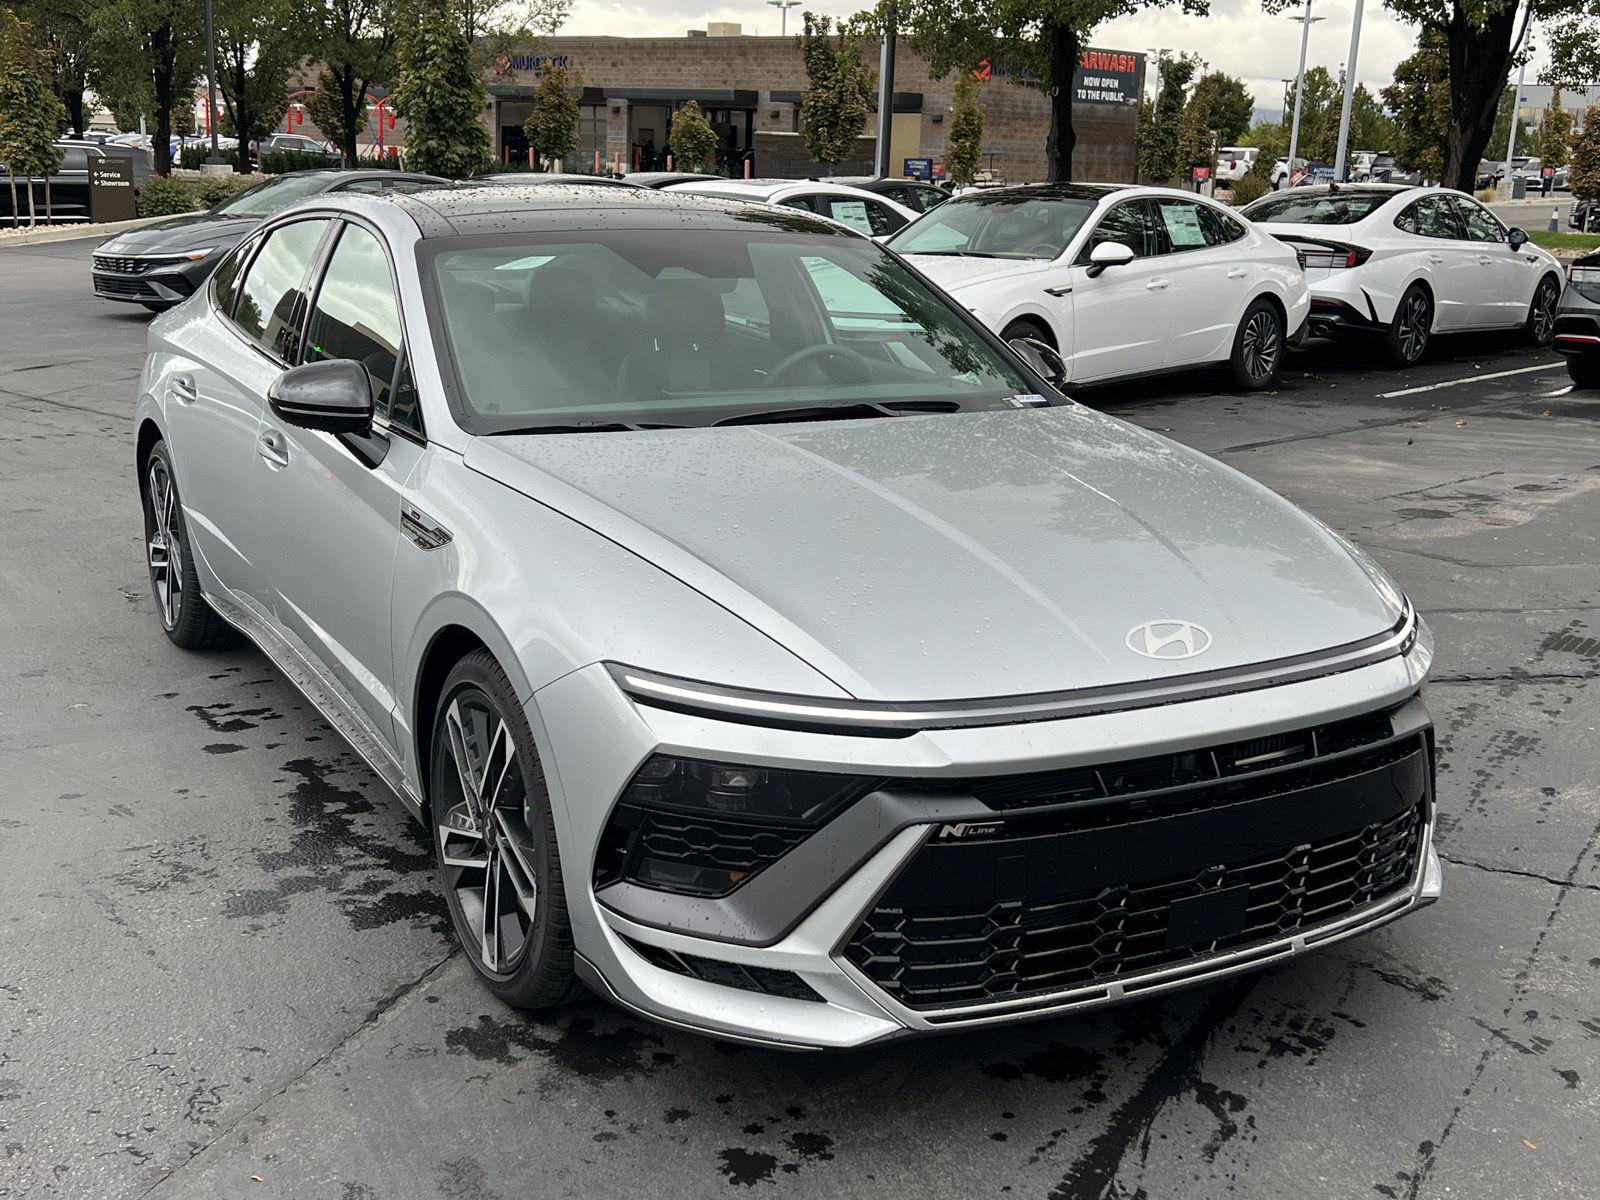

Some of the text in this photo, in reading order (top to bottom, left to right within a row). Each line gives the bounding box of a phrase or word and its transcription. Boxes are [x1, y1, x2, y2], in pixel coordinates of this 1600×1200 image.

[512, 55, 568, 70] MURDCK
[1080, 51, 1136, 73] ARWASH
[1083, 76, 1119, 89] NOW OPEN
[1077, 89, 1087, 99] TO
[1087, 90, 1100, 100] THE
[1101, 91, 1125, 102] PUBLIC
